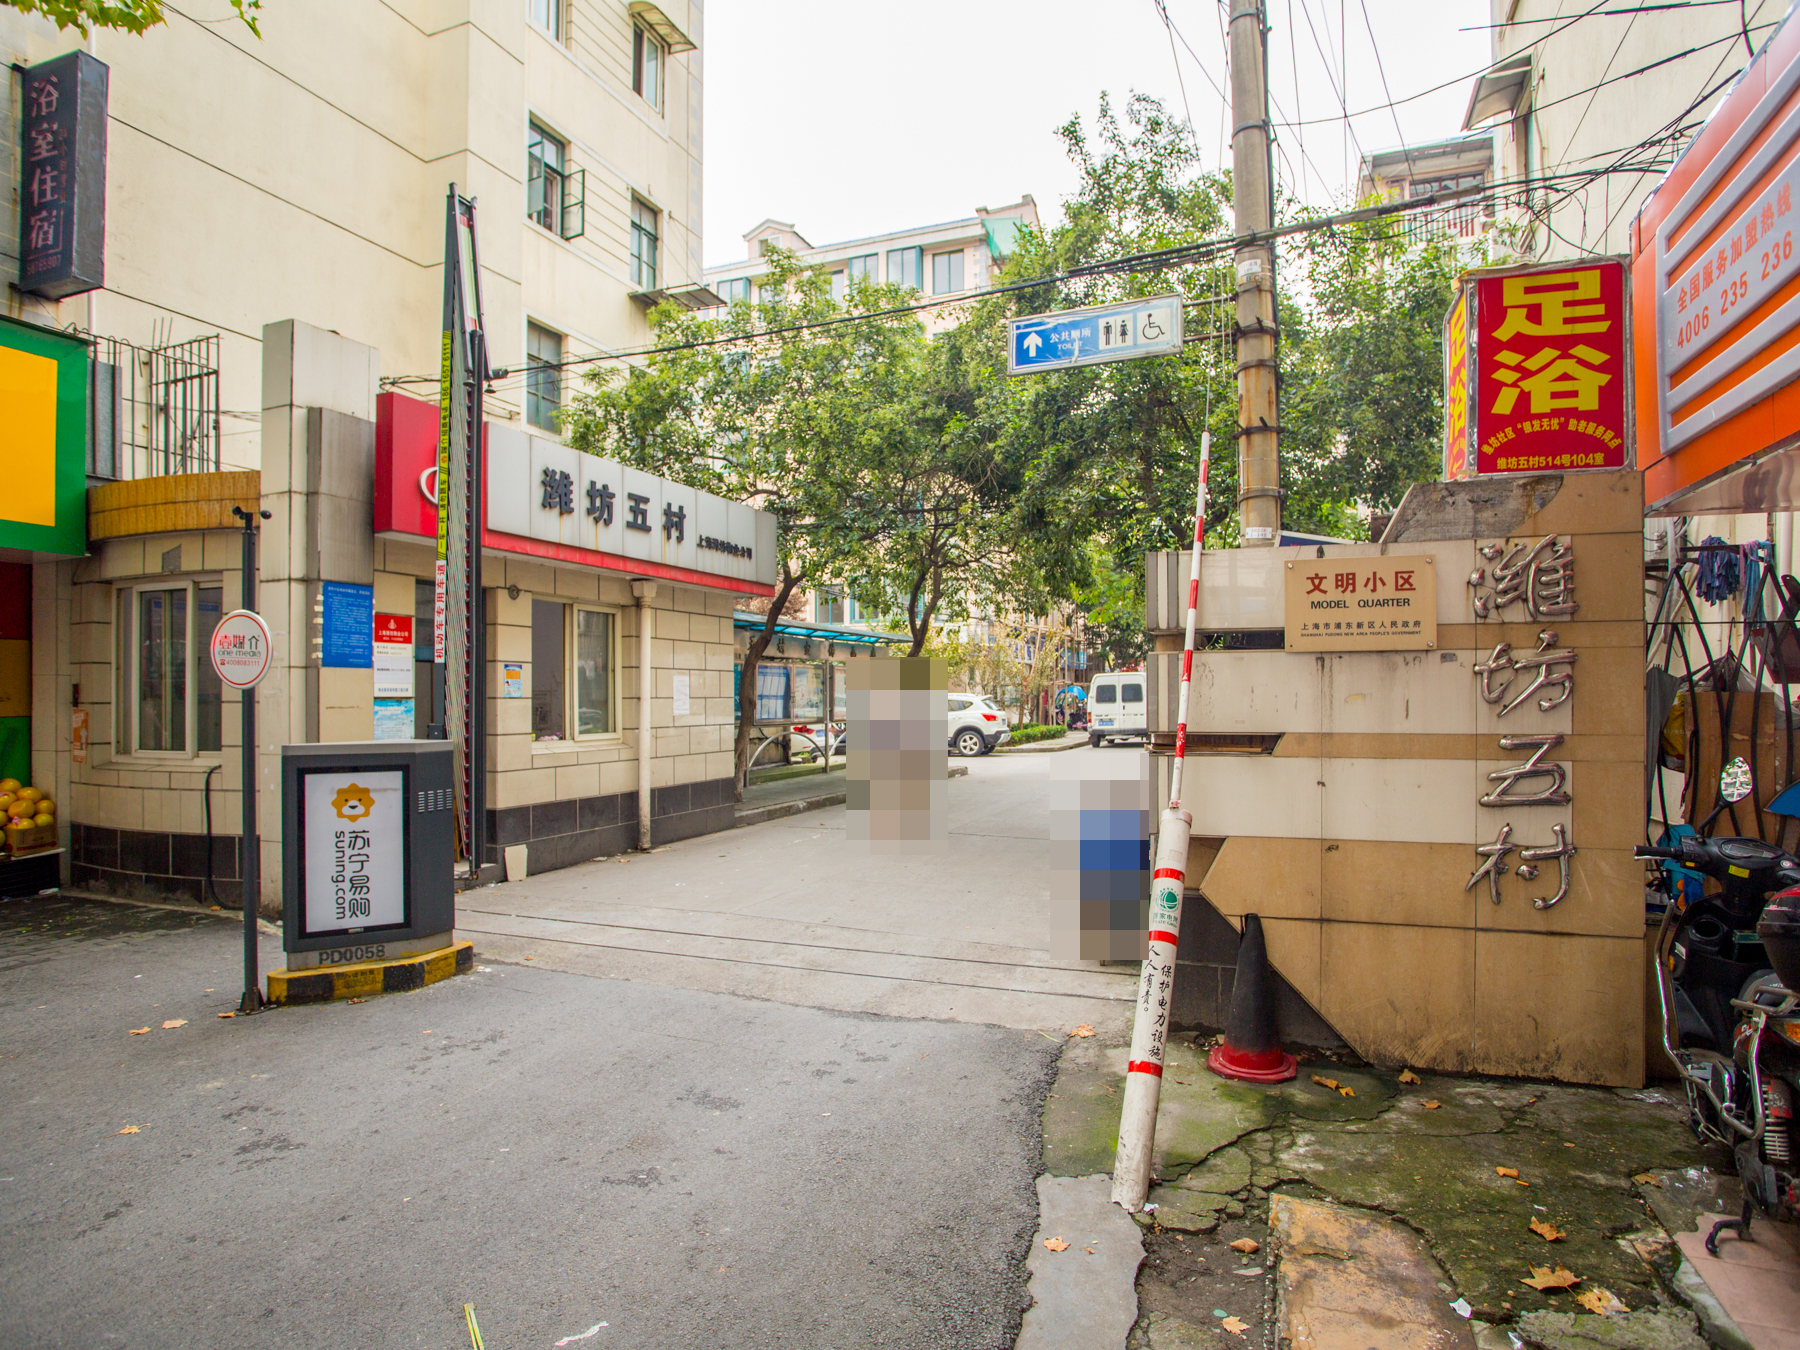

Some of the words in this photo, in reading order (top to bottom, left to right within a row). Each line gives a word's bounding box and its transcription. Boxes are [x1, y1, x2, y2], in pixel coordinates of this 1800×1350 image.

[29, 74, 59, 250] 浴室住宿
[1677, 181, 1792, 315] 全国服务加盟热线
[1677, 305, 1709, 349] 4006
[1720, 271, 1748, 316] 235
[1761, 230, 1793, 282] 236
[442, 364, 450, 384] 1657
[1050, 327, 1091, 343] 公共厕所
[1490, 269, 1612, 415] 足浴
[1497, 452, 1605, 470] 维坊五村514号104室
[541, 466, 686, 543] 潍坊五村
[436, 564, 446, 660] 机动车专用车道
[1306, 571, 1416, 595] 文明小区
[1311, 600, 1349, 609] MODEL
[1358, 598, 1410, 608] QUARTER
[218, 649, 234, 657] one
[1301, 620, 1421, 631] 上海市浦东新区人民政府
[1465, 534, 1580, 910] 潍坊五村
[331, 830, 346, 920] suning.com
[348, 829, 371, 919] 苏宁易购
[318, 944, 386, 965] PD0058
[1148, 964, 1173, 1061] 保护电力设施
